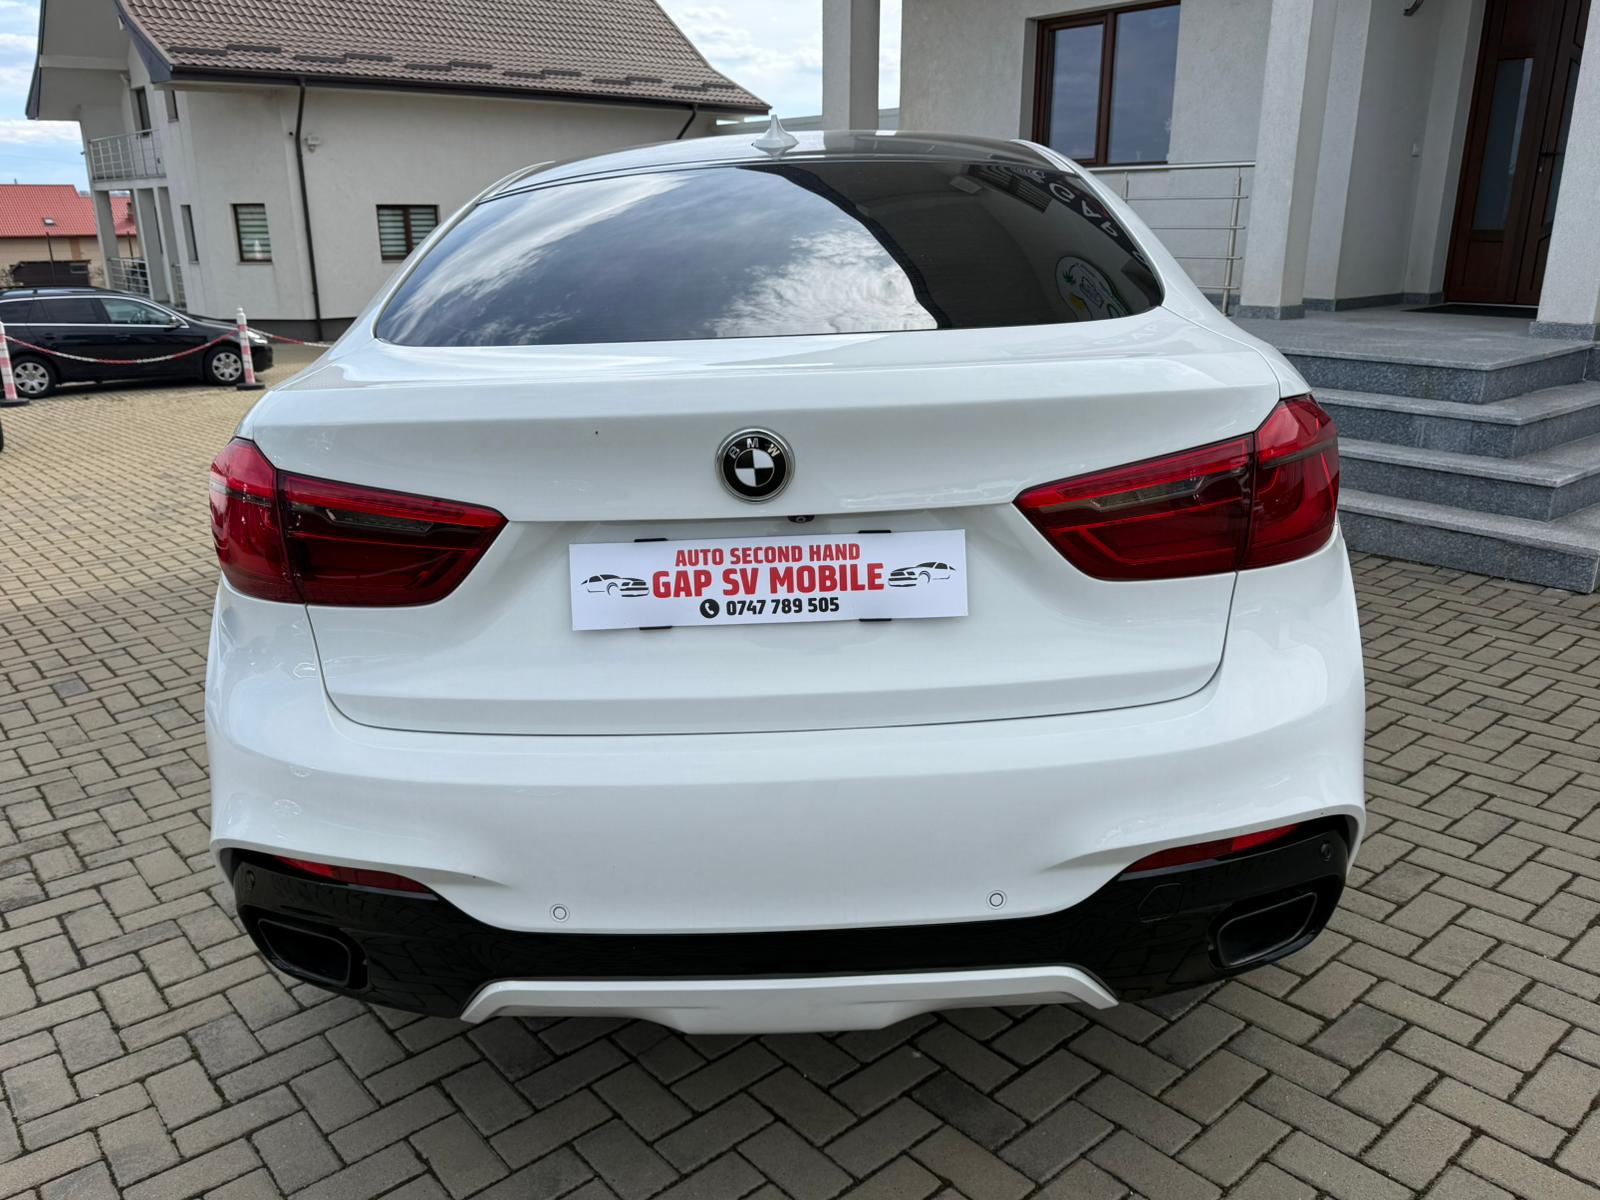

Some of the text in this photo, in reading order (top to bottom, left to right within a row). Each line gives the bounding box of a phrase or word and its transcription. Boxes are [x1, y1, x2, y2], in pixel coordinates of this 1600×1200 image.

[728, 437, 780, 459] BMW
[675, 543, 860, 567] AUTO SECOND HAND
[652, 563, 884, 598] GAP SV MOBILE
[726, 597, 840, 616] 0747 789 505
